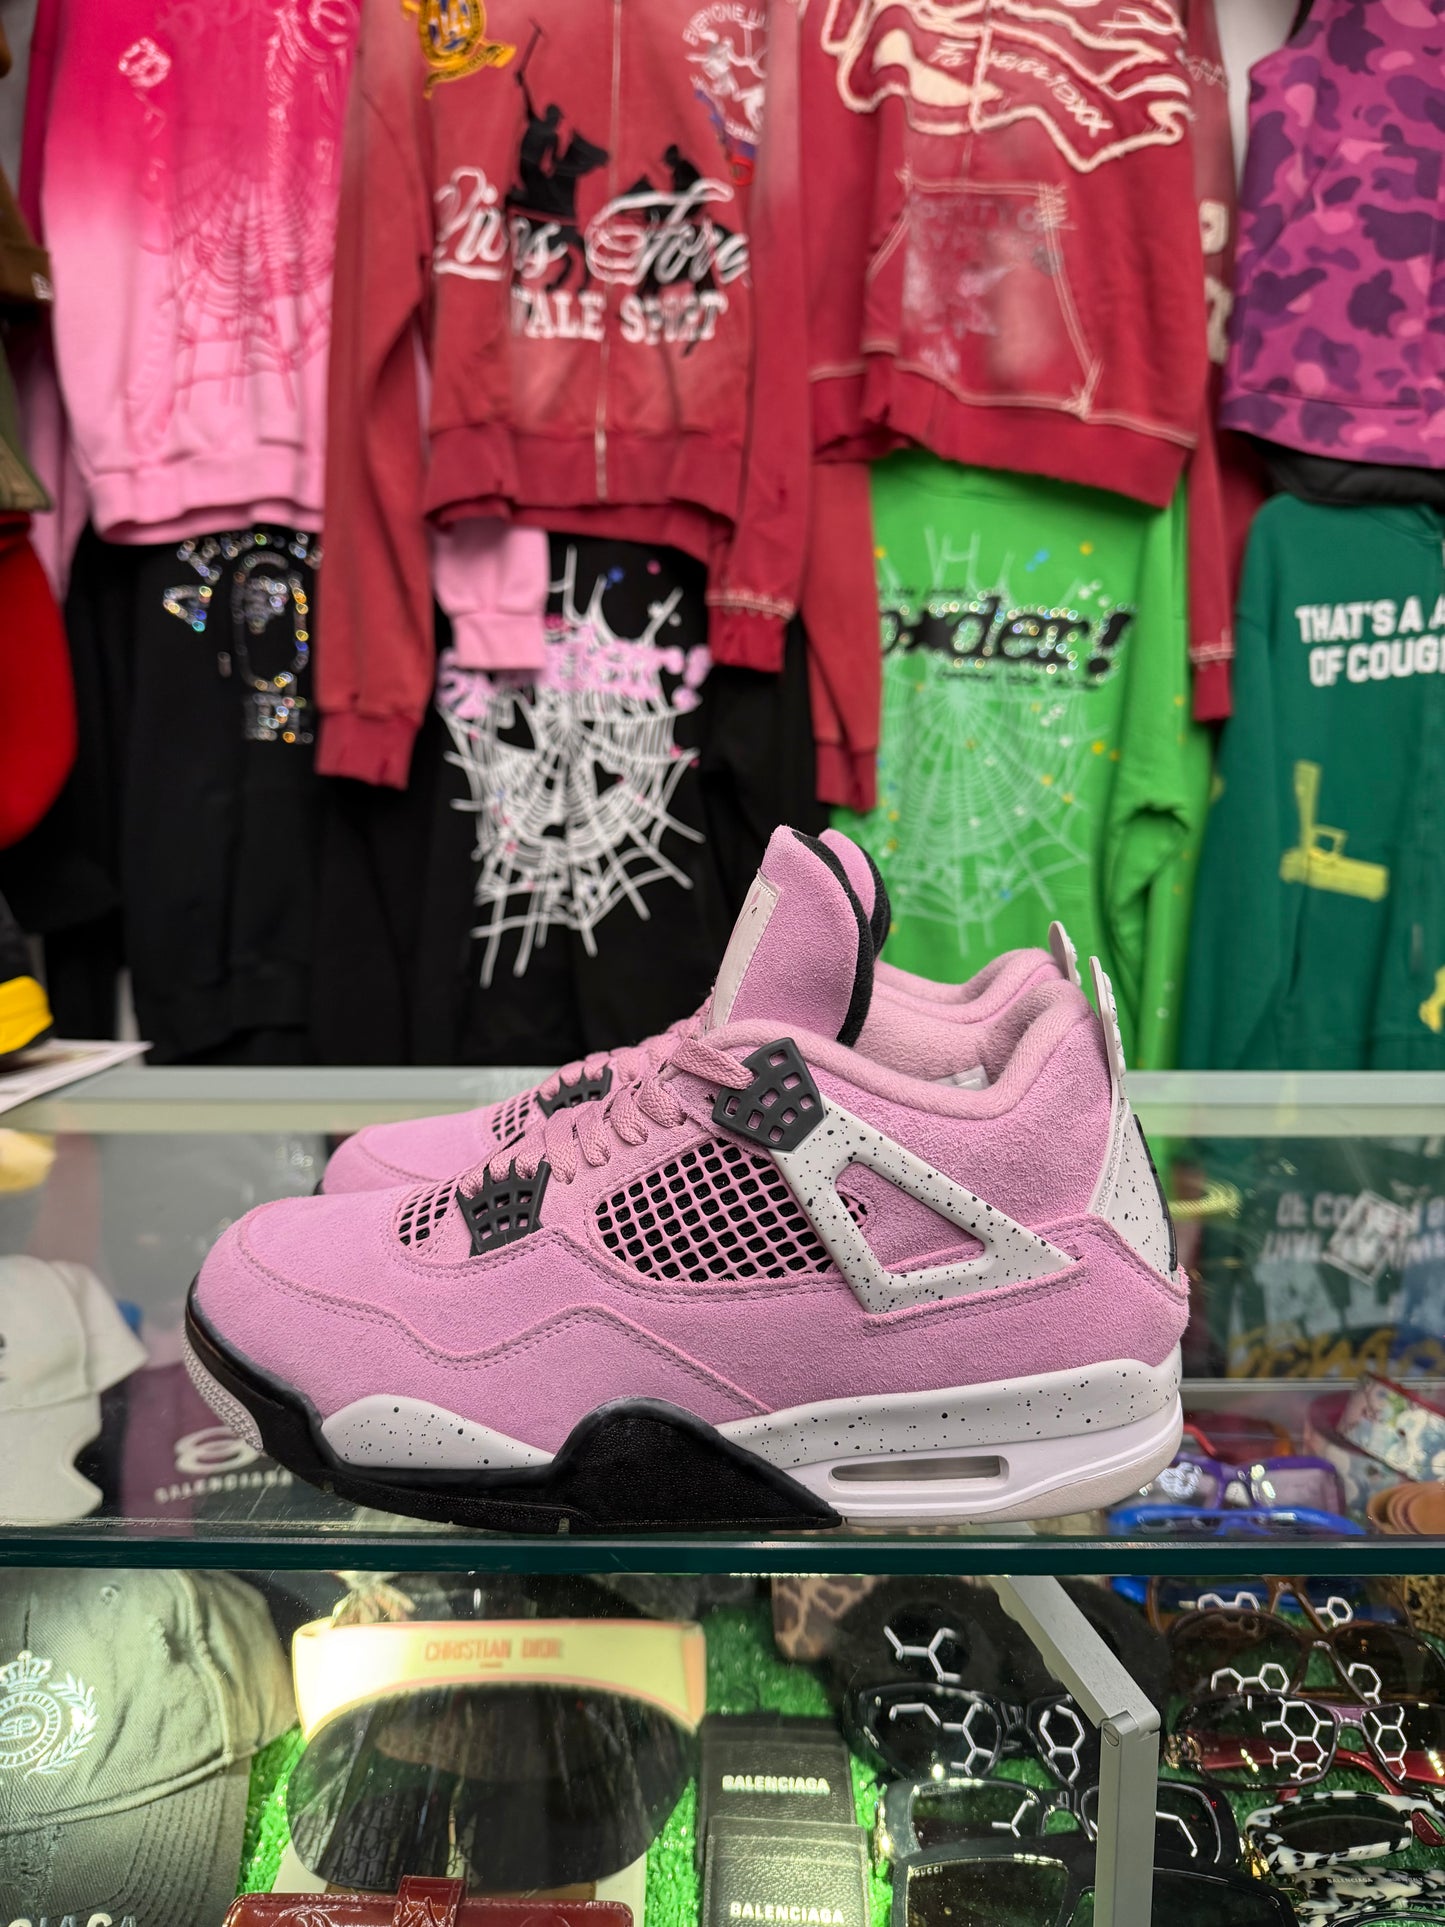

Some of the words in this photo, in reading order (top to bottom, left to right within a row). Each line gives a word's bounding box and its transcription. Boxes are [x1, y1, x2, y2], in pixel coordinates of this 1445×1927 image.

[1295, 599, 1397, 643] THAT'S
[1398, 595, 1423, 633] A
[1309, 645, 1345, 687] OF
[1347, 634, 1445, 683] COUG
[425, 1638, 512, 1661] CHRISTIAN
[722, 1775, 831, 1795] BALENCIAGA
[914, 1865, 944, 1877] GUCCI
[730, 1901, 845, 1924] BALENCIAGA
